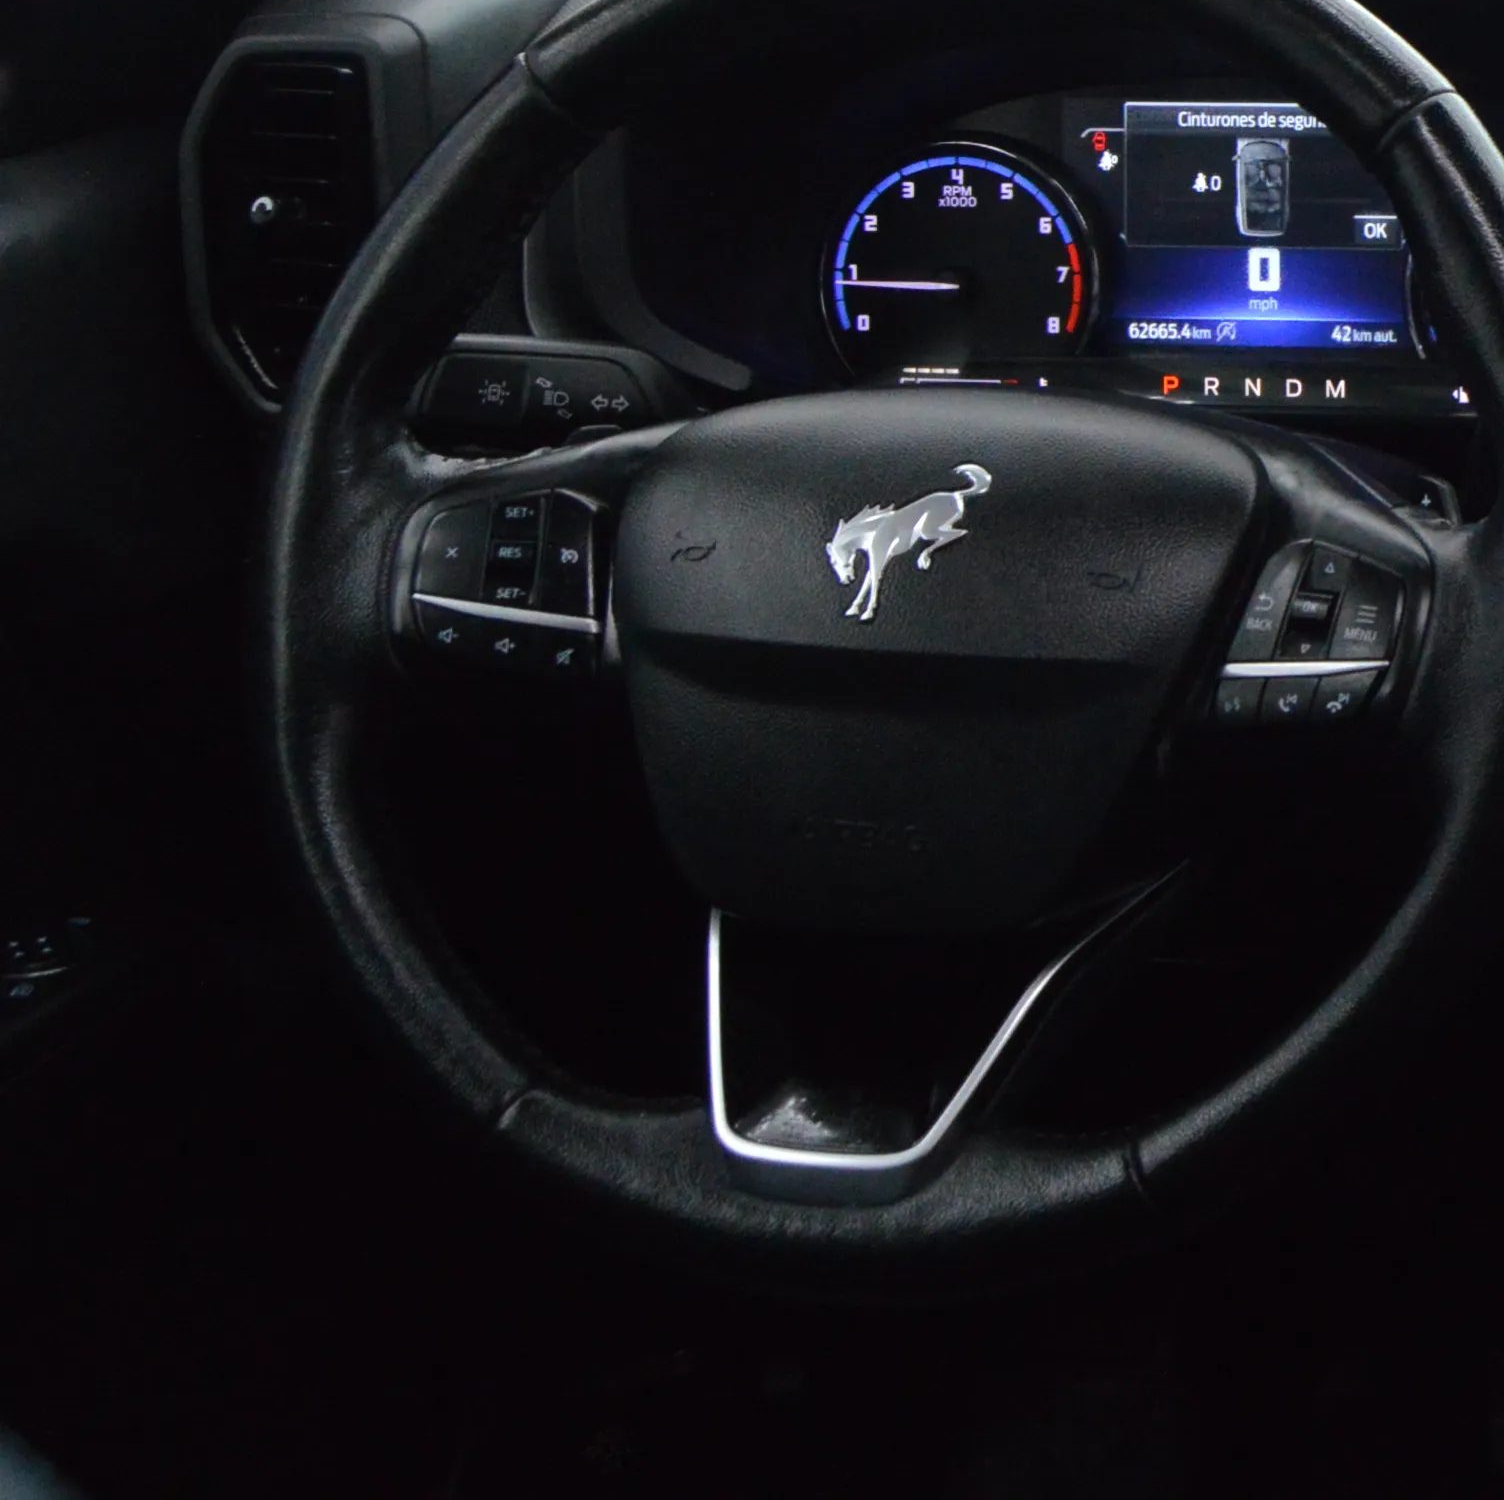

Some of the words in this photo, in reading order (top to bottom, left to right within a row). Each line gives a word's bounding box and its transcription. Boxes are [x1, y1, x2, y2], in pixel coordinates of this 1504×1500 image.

[1178, 111, 1256, 128] Cinturones
[1257, 111, 1276, 128] de
[951, 169, 964, 184] 4
[1210, 175, 1222, 192] 0
[902, 181, 915, 198] 3
[943, 186, 972, 197] RPM
[1000, 183, 1013, 200] 5
[938, 197, 977, 208] x1000
[863, 215, 878, 231] 2
[1039, 217, 1052, 234] 6
[1363, 223, 1388, 239] OK
[848, 264, 858, 280] 1
[1056, 266, 1070, 283] 7
[1249, 247, 1280, 291] 0
[1249, 297, 1278, 312] mph
[857, 315, 870, 331] 0
[1047, 316, 1060, 333] 8
[1373, 330, 1398, 343] aut.
[1163, 375, 1179, 395] P
[1204, 377, 1220, 396] R
[1244, 378, 1261, 397] N
[1286, 378, 1302, 398] D
[1325, 379, 1345, 398] M
[499, 546, 522, 559] RES
[1343, 628, 1378, 642] MENU
